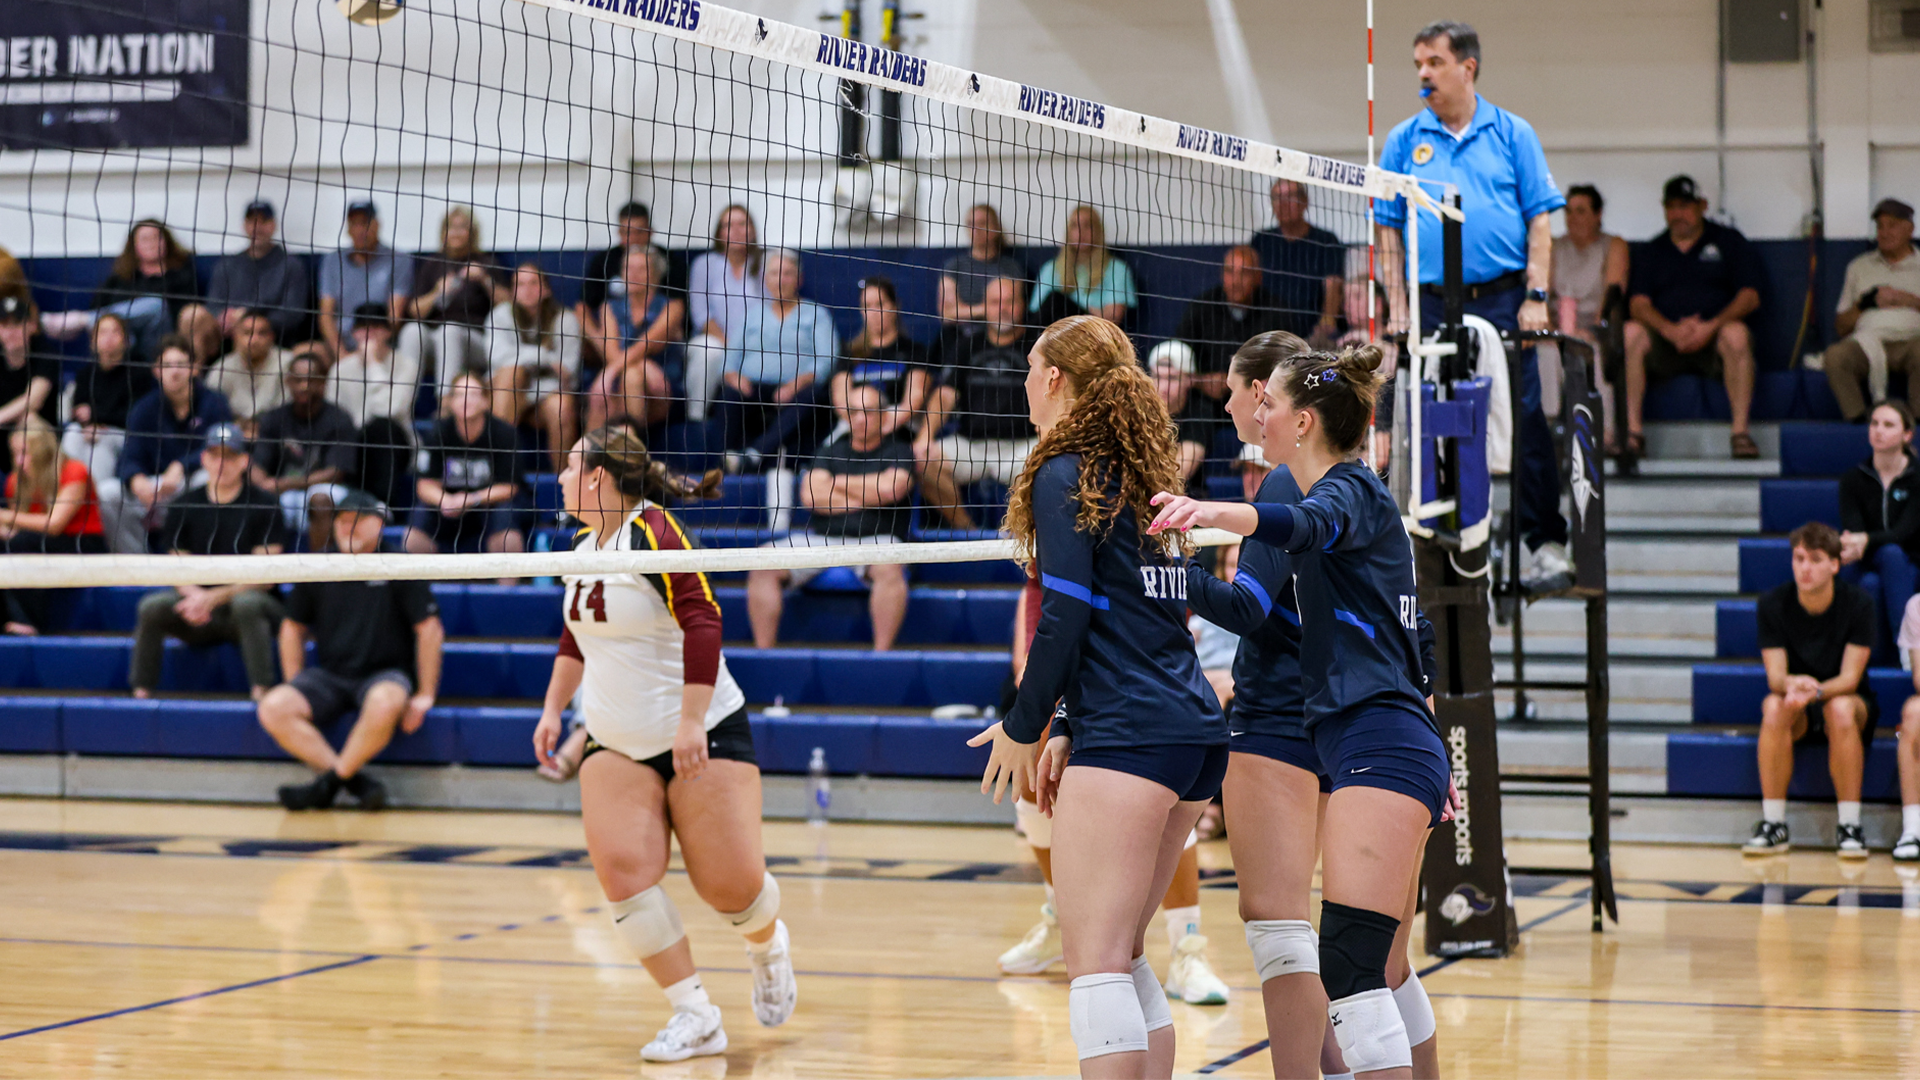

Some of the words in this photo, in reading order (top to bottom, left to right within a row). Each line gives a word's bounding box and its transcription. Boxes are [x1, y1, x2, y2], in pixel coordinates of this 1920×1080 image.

[622, 0, 701, 31] RAIDERS
[68, 32, 215, 75] NATION
[816, 33, 867, 73] RIVIER
[868, 46, 928, 87] RAIDERS
[1018, 85, 1058, 119] RIVIER
[1057, 95, 1105, 130] RAIDERS
[569, 579, 607, 622] 14
